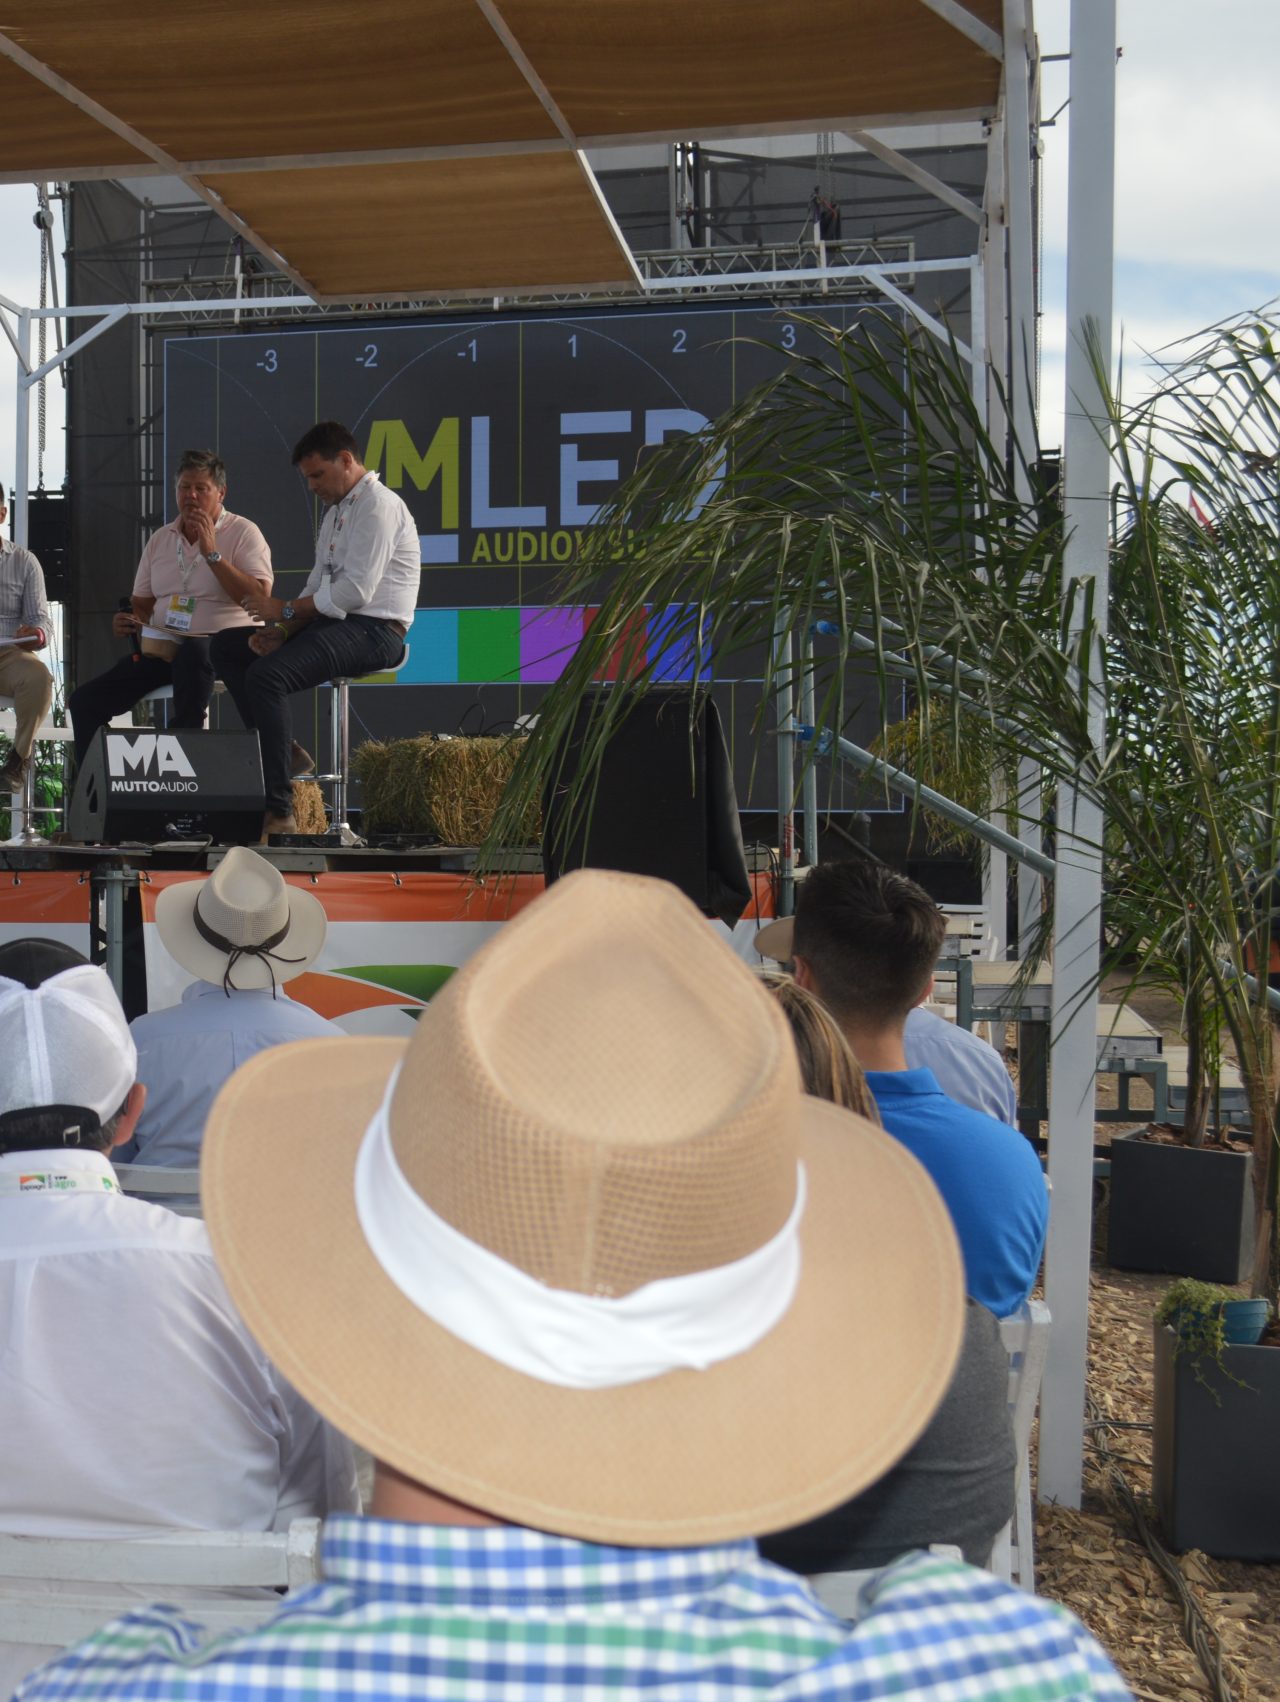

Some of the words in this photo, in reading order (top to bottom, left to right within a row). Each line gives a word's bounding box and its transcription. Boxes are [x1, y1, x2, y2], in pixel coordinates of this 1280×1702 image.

[256, 349, 279, 373] -3
[355, 343, 378, 367] -2
[457, 338, 478, 362] -1
[568, 334, 577, 358] 1
[672, 328, 687, 353] 2
[781, 324, 796, 349] 3
[106, 734, 197, 777] MA
[111, 781, 199, 792] MUTTOAUDIO
[54, 1180, 76, 1190] agro
